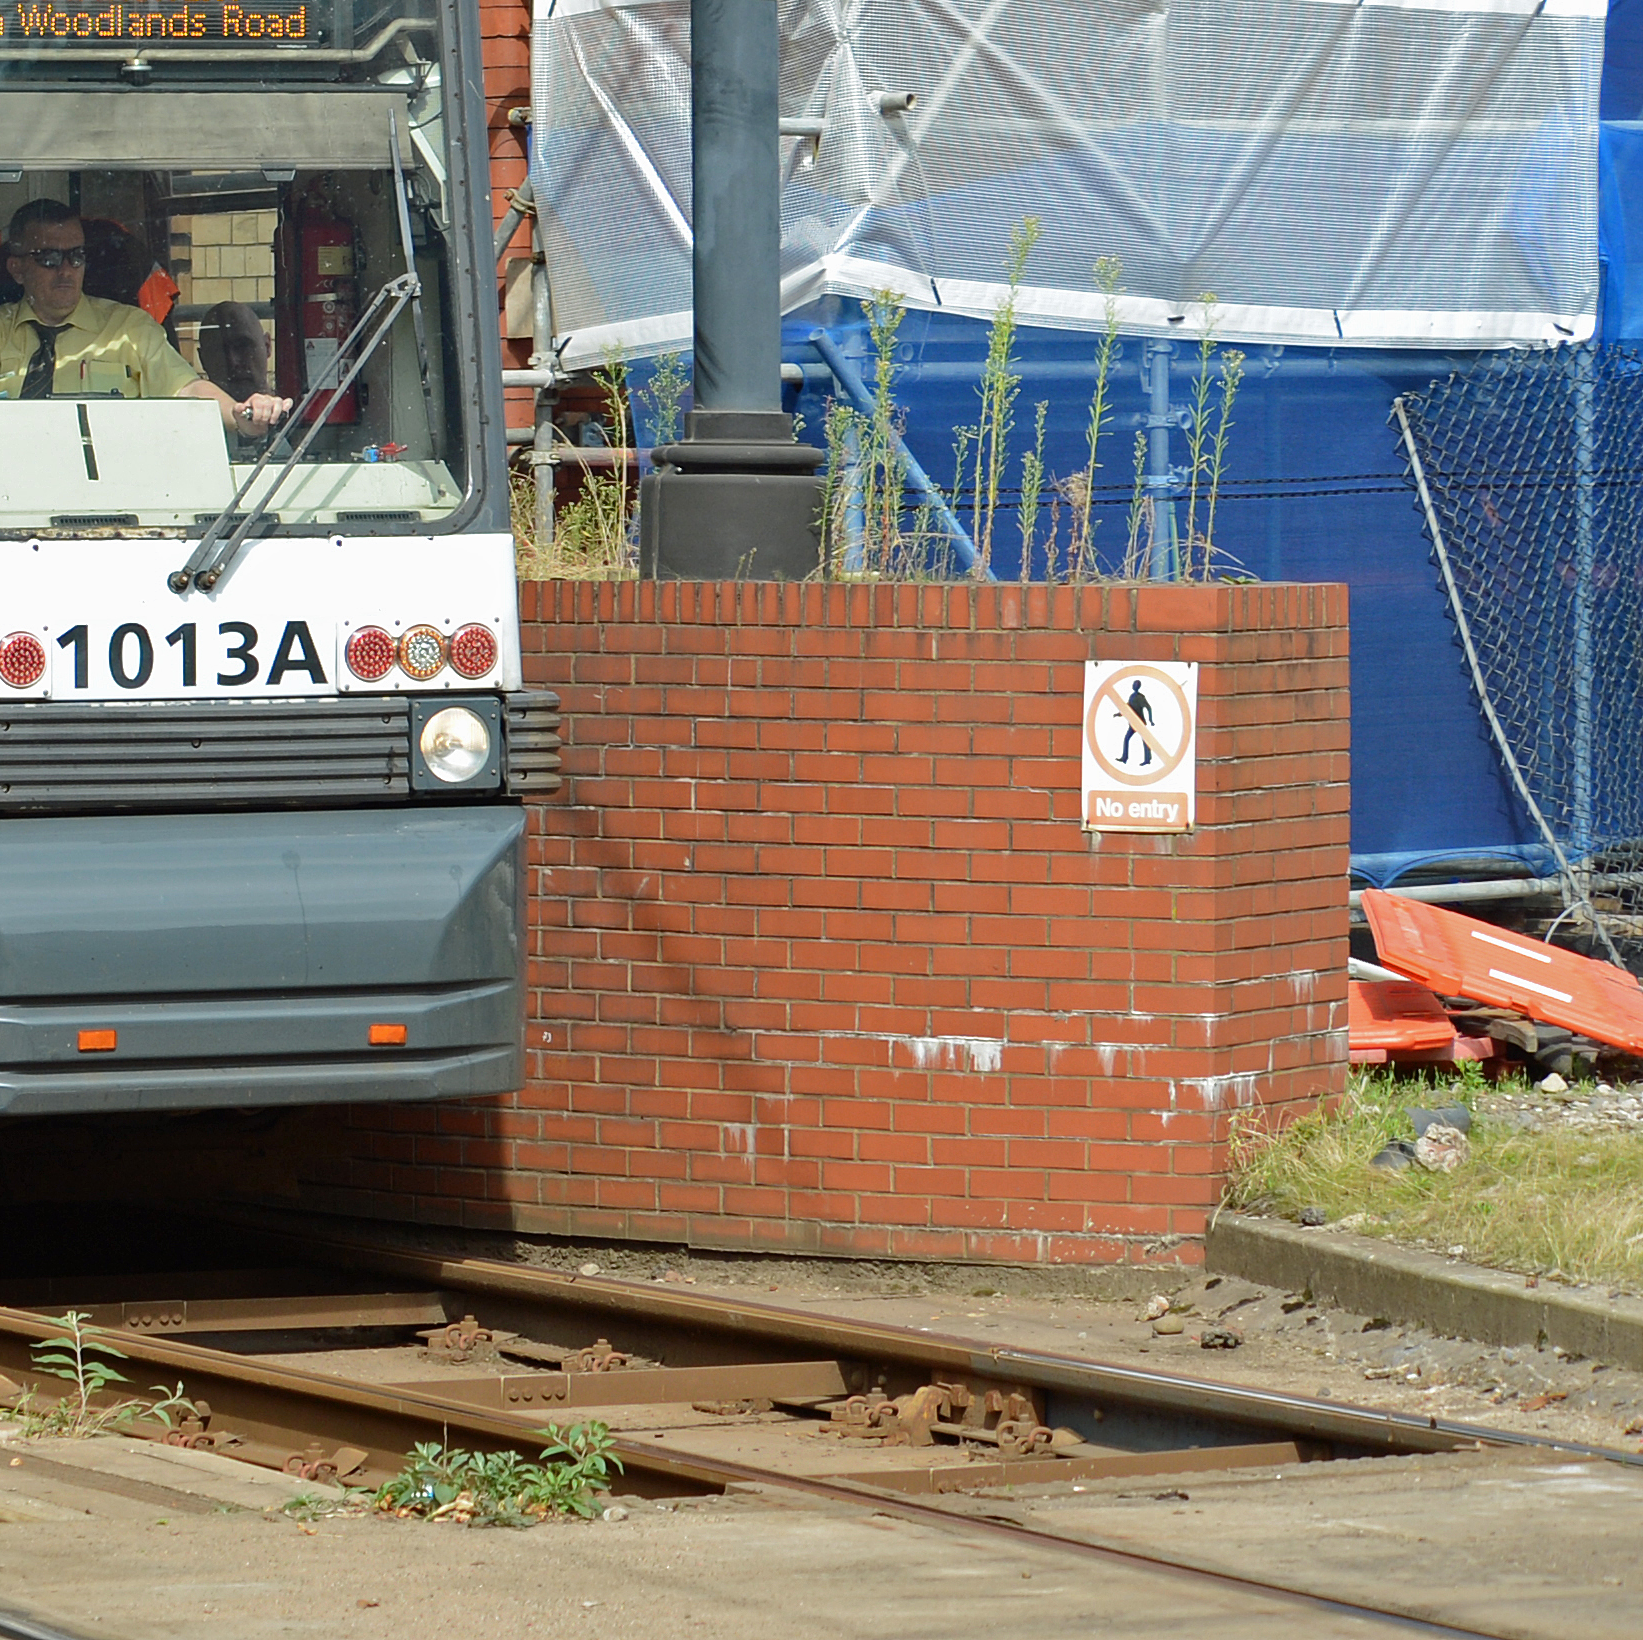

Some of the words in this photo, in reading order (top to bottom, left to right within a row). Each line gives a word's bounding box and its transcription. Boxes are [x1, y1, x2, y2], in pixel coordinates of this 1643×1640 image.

[18, 4, 206, 38] Woodlands
[223, 6, 307, 39] Road
[56, 620, 329, 690] 1013A
[1096, 797, 1125, 818] No
[1128, 798, 1179, 823] entry
